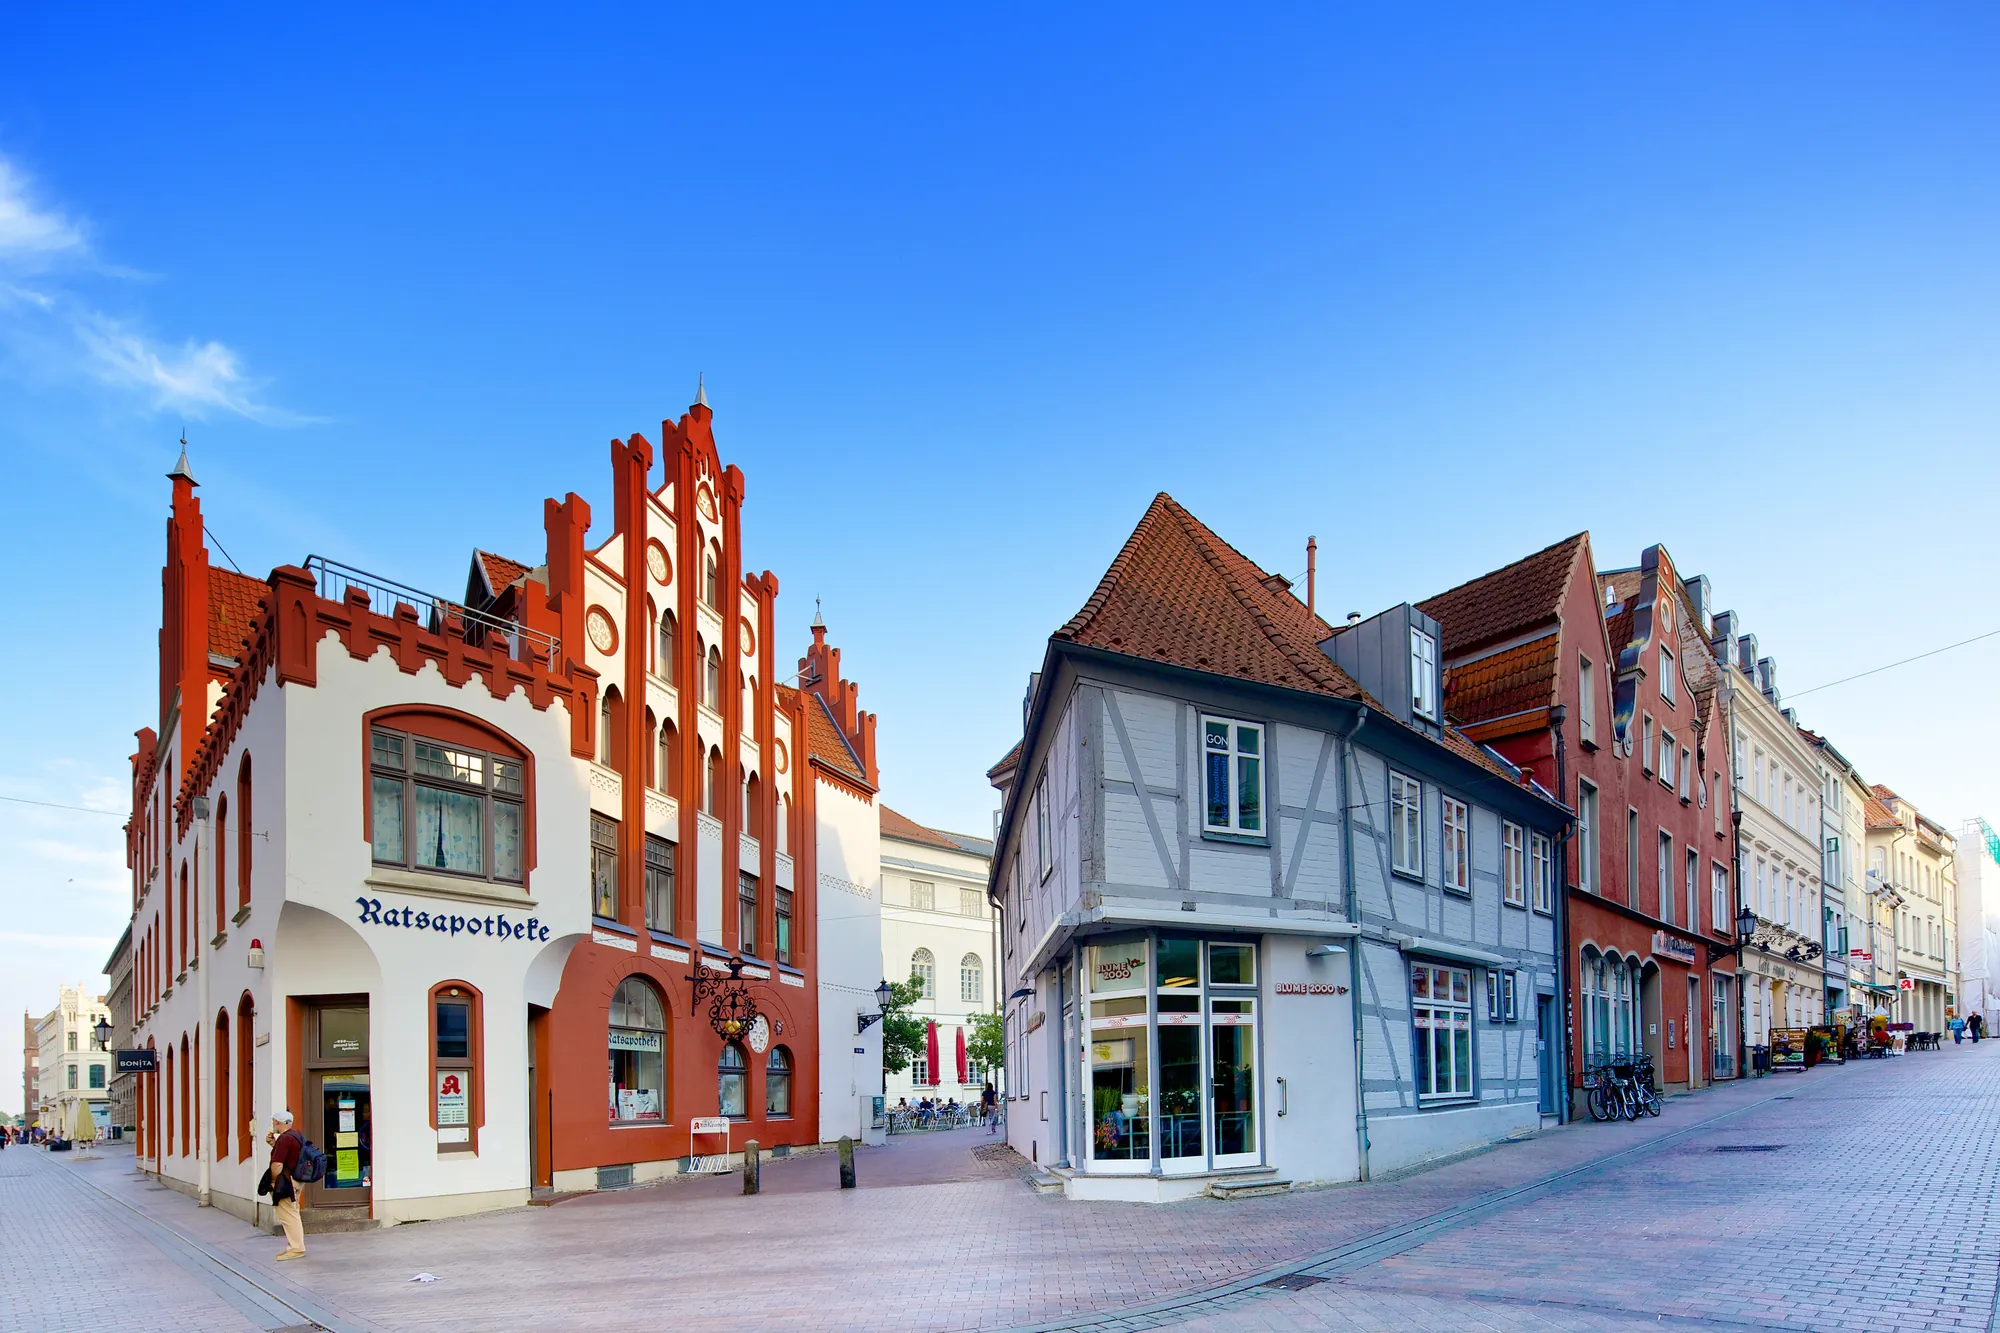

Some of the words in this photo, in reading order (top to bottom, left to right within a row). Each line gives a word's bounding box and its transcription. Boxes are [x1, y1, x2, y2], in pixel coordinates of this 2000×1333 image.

[1206, 733, 1228, 746] GON
[1212, 755, 1221, 804] Verwaltung
[355, 896, 550, 942] Ratsapotheke
[1095, 962, 1128, 974] BLUME
[1103, 970, 1131, 980] 2000
[1275, 983, 1307, 995] BLUME
[1309, 983, 1336, 995] 2000
